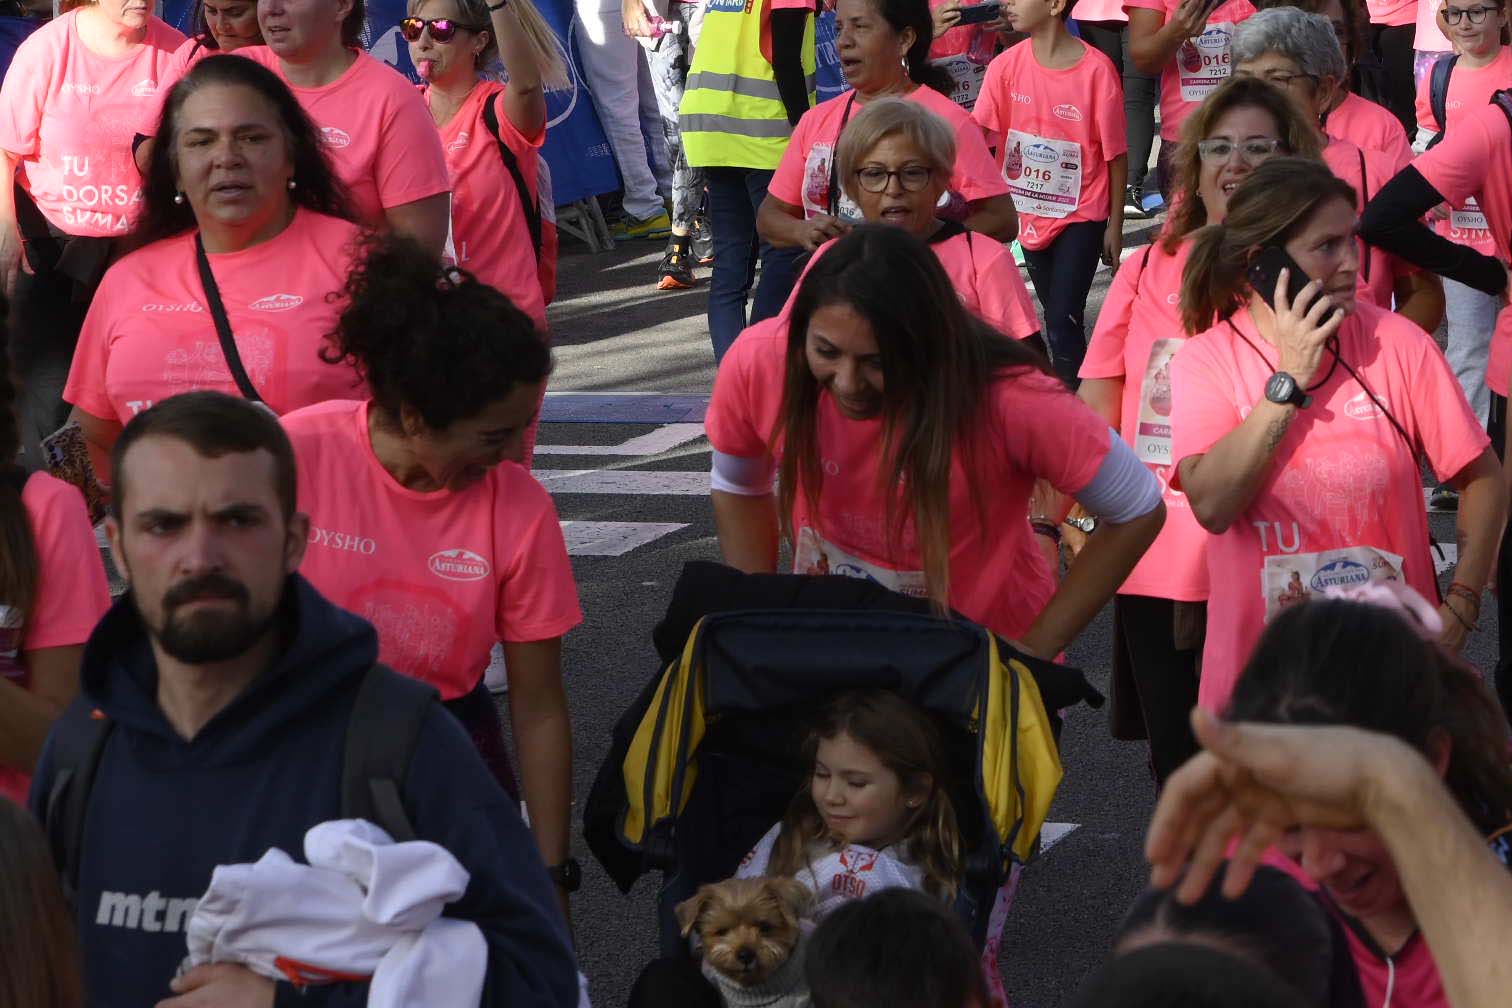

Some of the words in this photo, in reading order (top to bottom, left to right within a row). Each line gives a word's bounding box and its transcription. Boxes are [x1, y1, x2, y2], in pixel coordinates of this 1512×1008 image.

[1202, 54, 1230, 66] 016
[62, 155, 89, 177] TU
[1024, 166, 1051, 181] 016
[1253, 521, 1300, 552] TU
[1314, 570, 1368, 592] ASTURIANA
